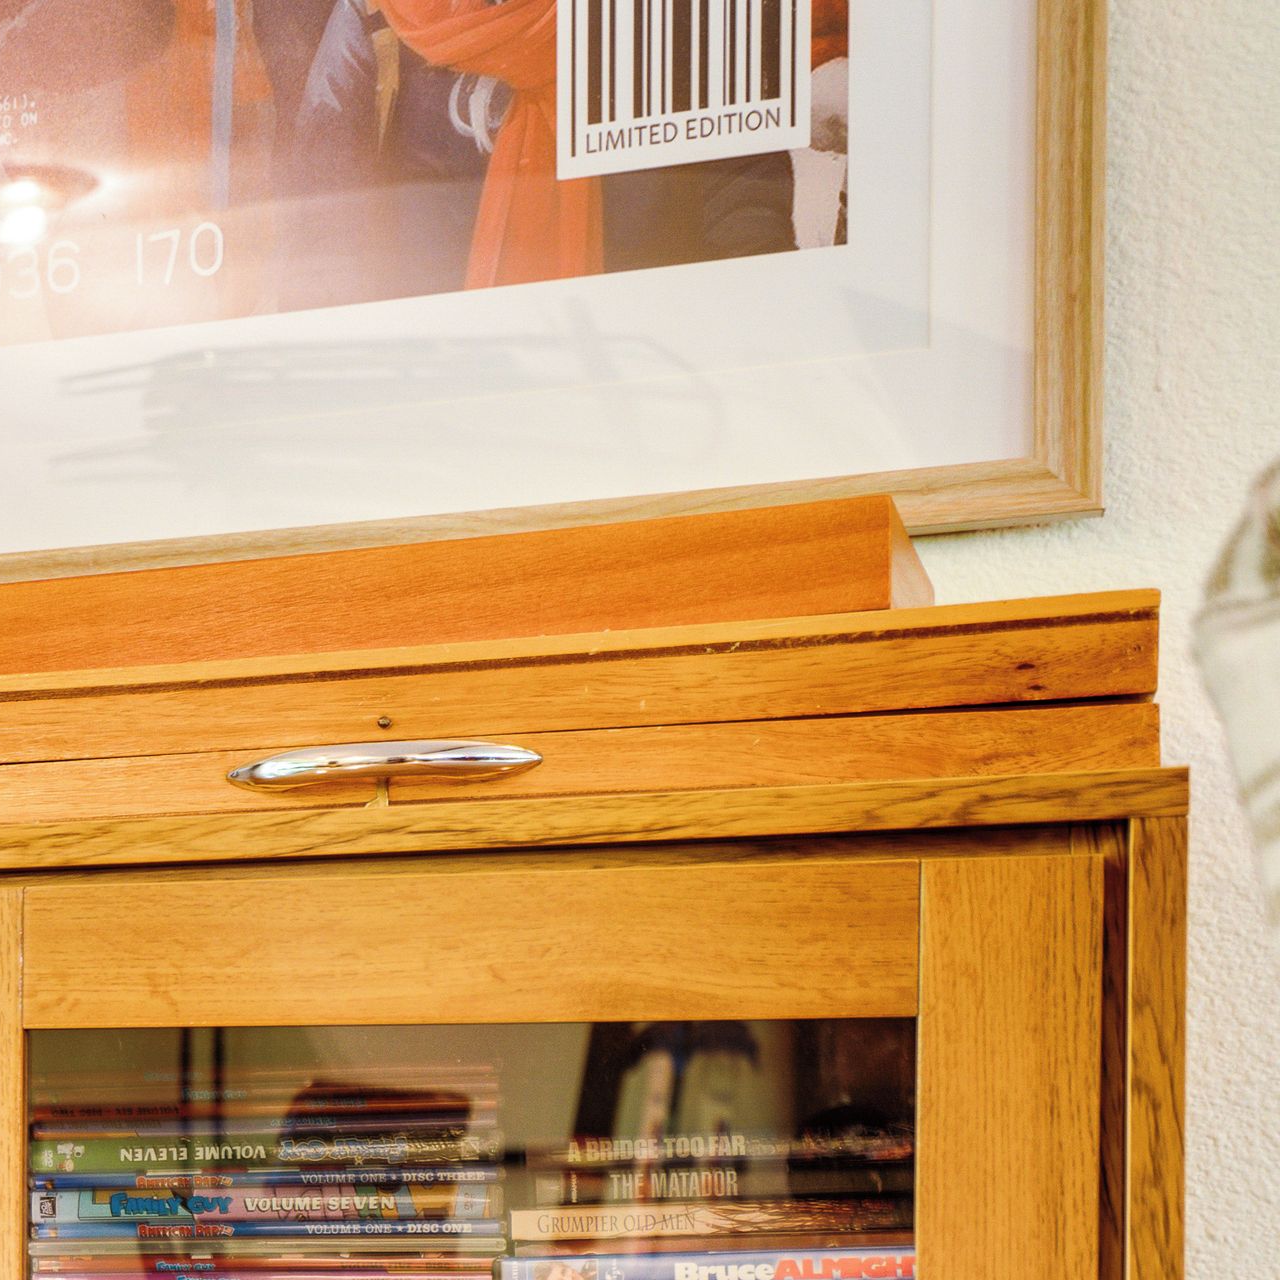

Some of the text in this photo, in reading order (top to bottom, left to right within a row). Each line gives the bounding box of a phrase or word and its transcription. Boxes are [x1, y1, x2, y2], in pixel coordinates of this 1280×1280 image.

[585, 106, 782, 154] LIMITED EDITION
[136, 221, 224, 287] 170
[568, 1134, 747, 1163] A BRIDGE TOO FAR
[301, 1170, 486, 1184] VOLUME ONE DISC THREE
[610, 1167, 739, 1200] THE MATADOR
[109, 1193, 396, 1217] FAMILY GUY VOLUME SEVEN
[305, 1222, 473, 1236] VOLUME ONE DISC ONE
